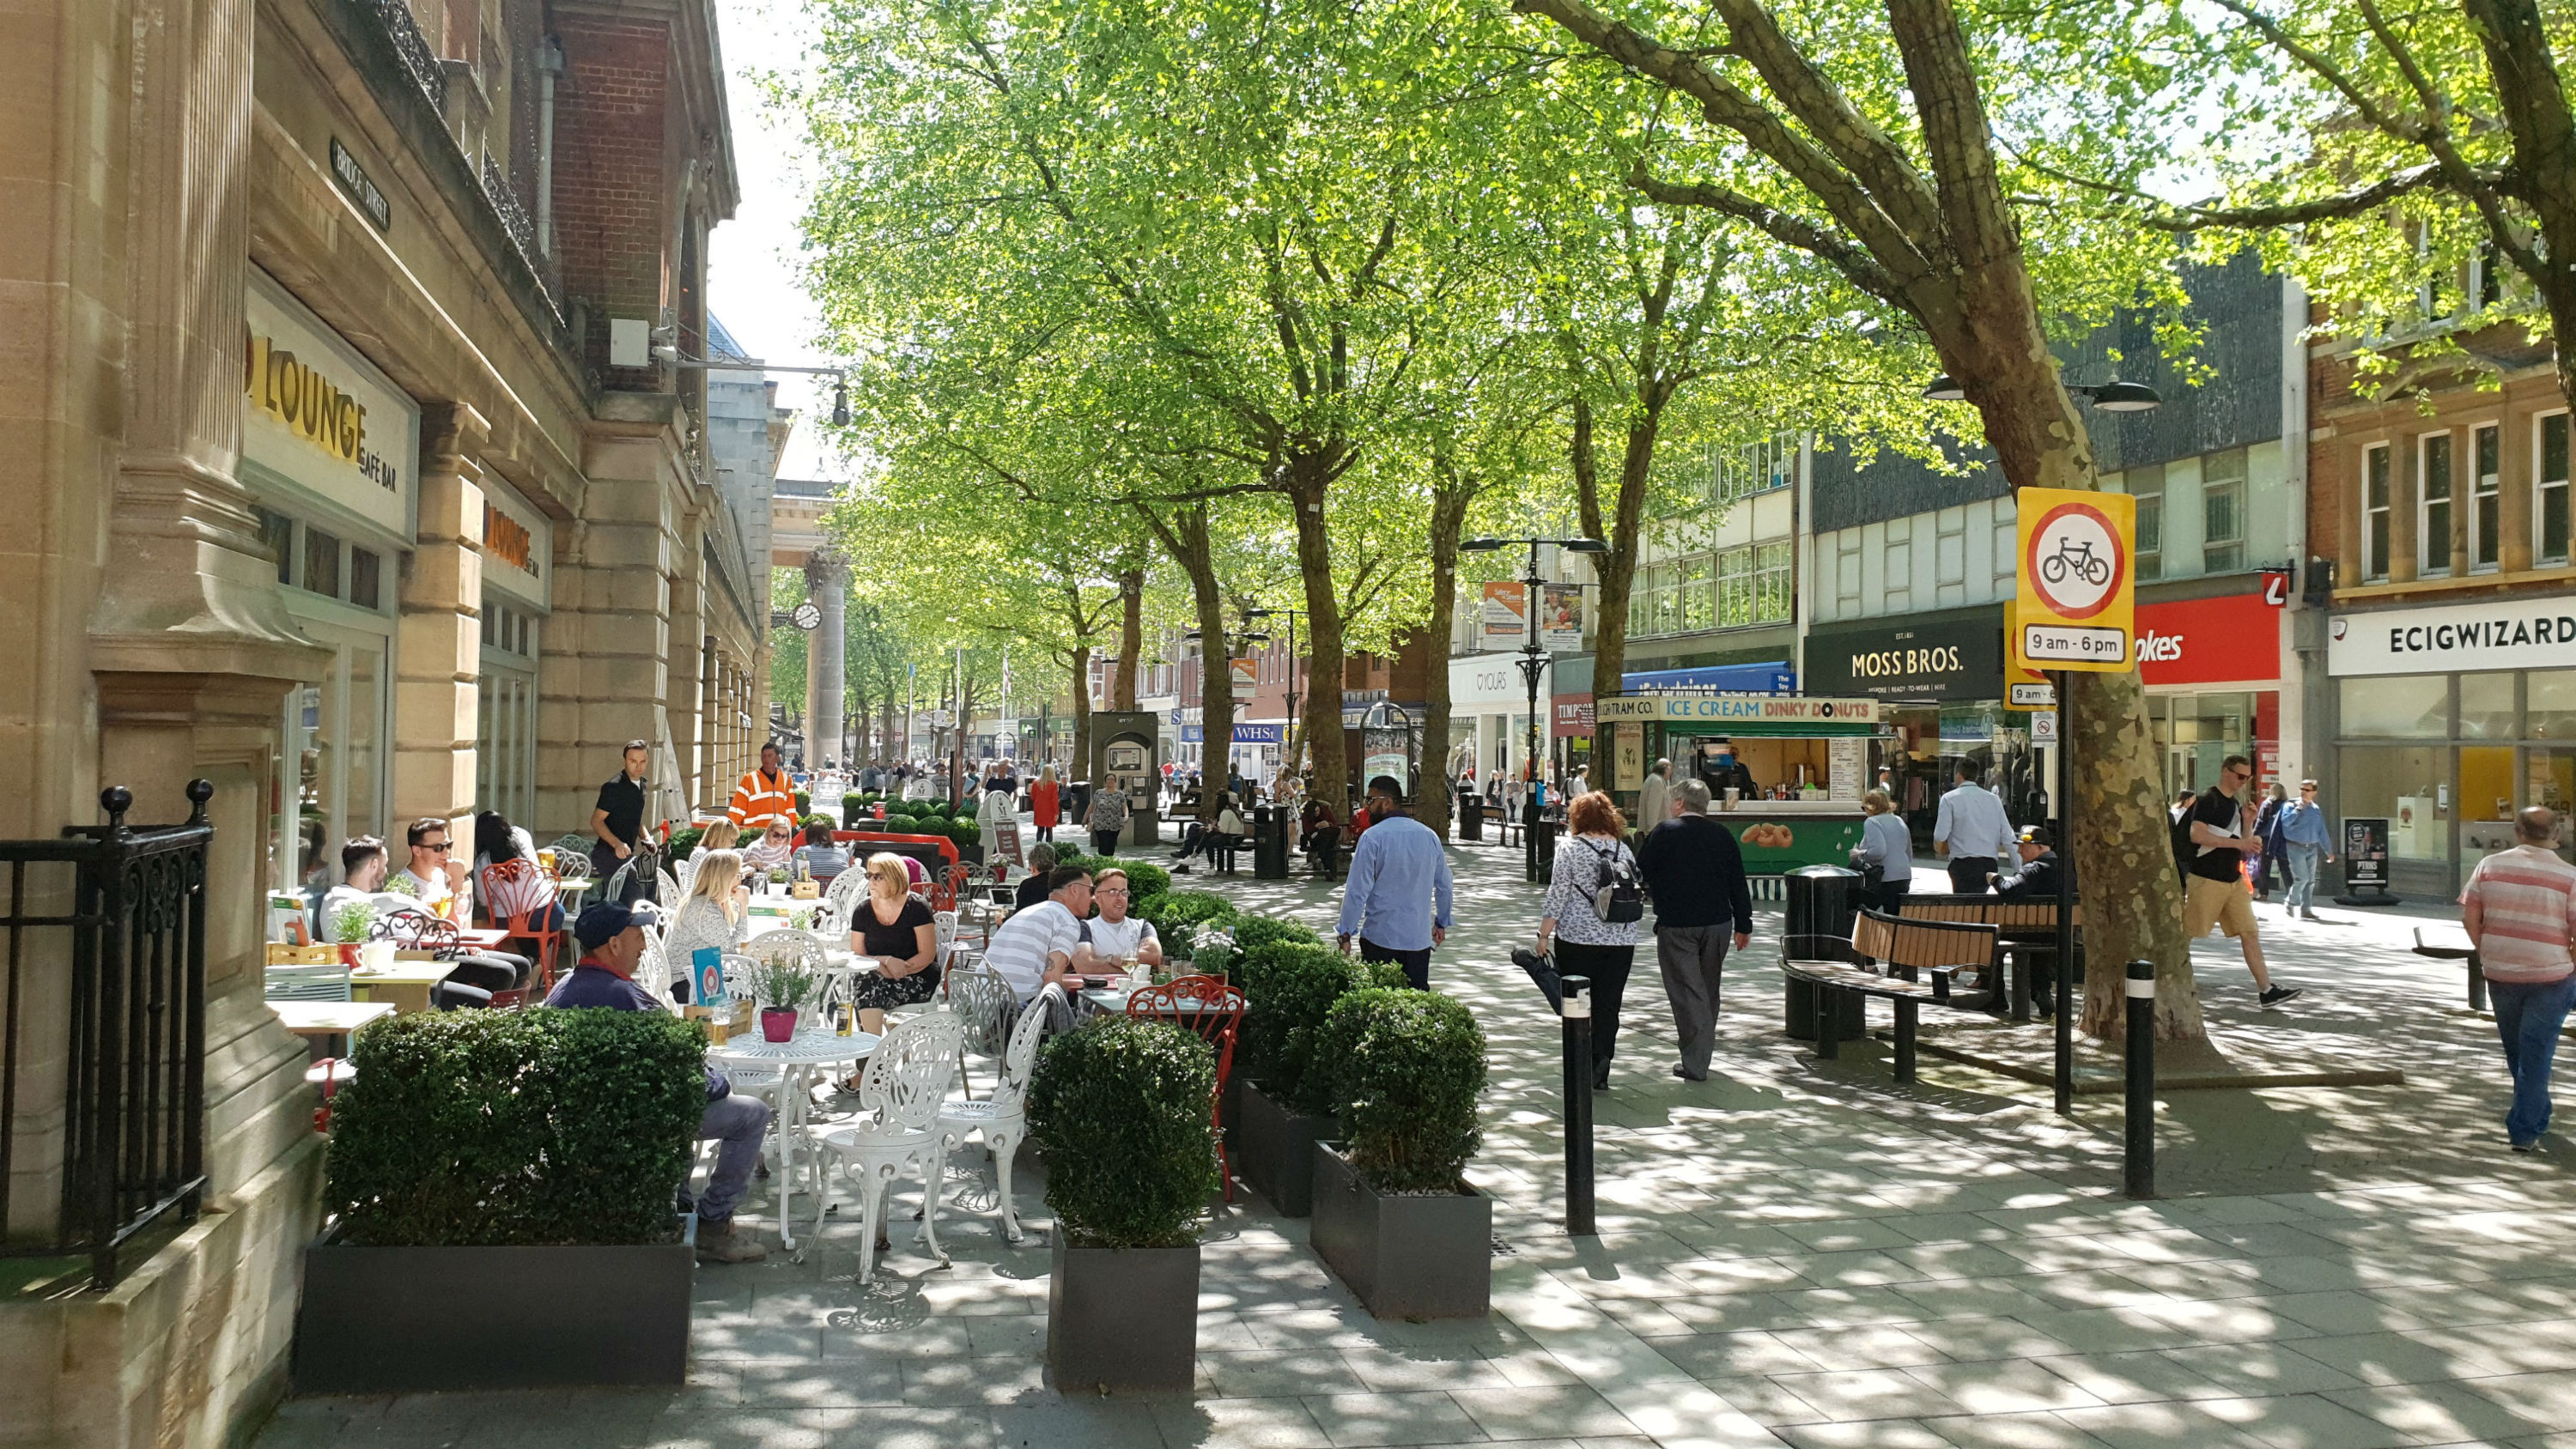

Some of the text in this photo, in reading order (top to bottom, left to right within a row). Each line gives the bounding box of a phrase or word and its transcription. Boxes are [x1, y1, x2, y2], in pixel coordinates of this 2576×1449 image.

[337, 143, 387, 225] BRIDGE STREET
[264, 336, 367, 465] LOUNGE
[381, 461, 396, 494] BAR
[2032, 634, 2042, 649] 9
[2046, 639, 2069, 650] am
[2081, 637, 2091, 650] 6
[2094, 640, 2117, 654] pm
[2391, 616, 2576, 652] ECIGWIZARD
[1851, 646, 1964, 678] MOSS BROS.
[1484, 671, 1507, 690] YOURS
[2016, 689, 2023, 699] 9
[1611, 701, 1635, 715] TRAM
[1637, 701, 1653, 714] CO.
[1666, 700, 1868, 718] ICE CREAM DINKY DONUTS
